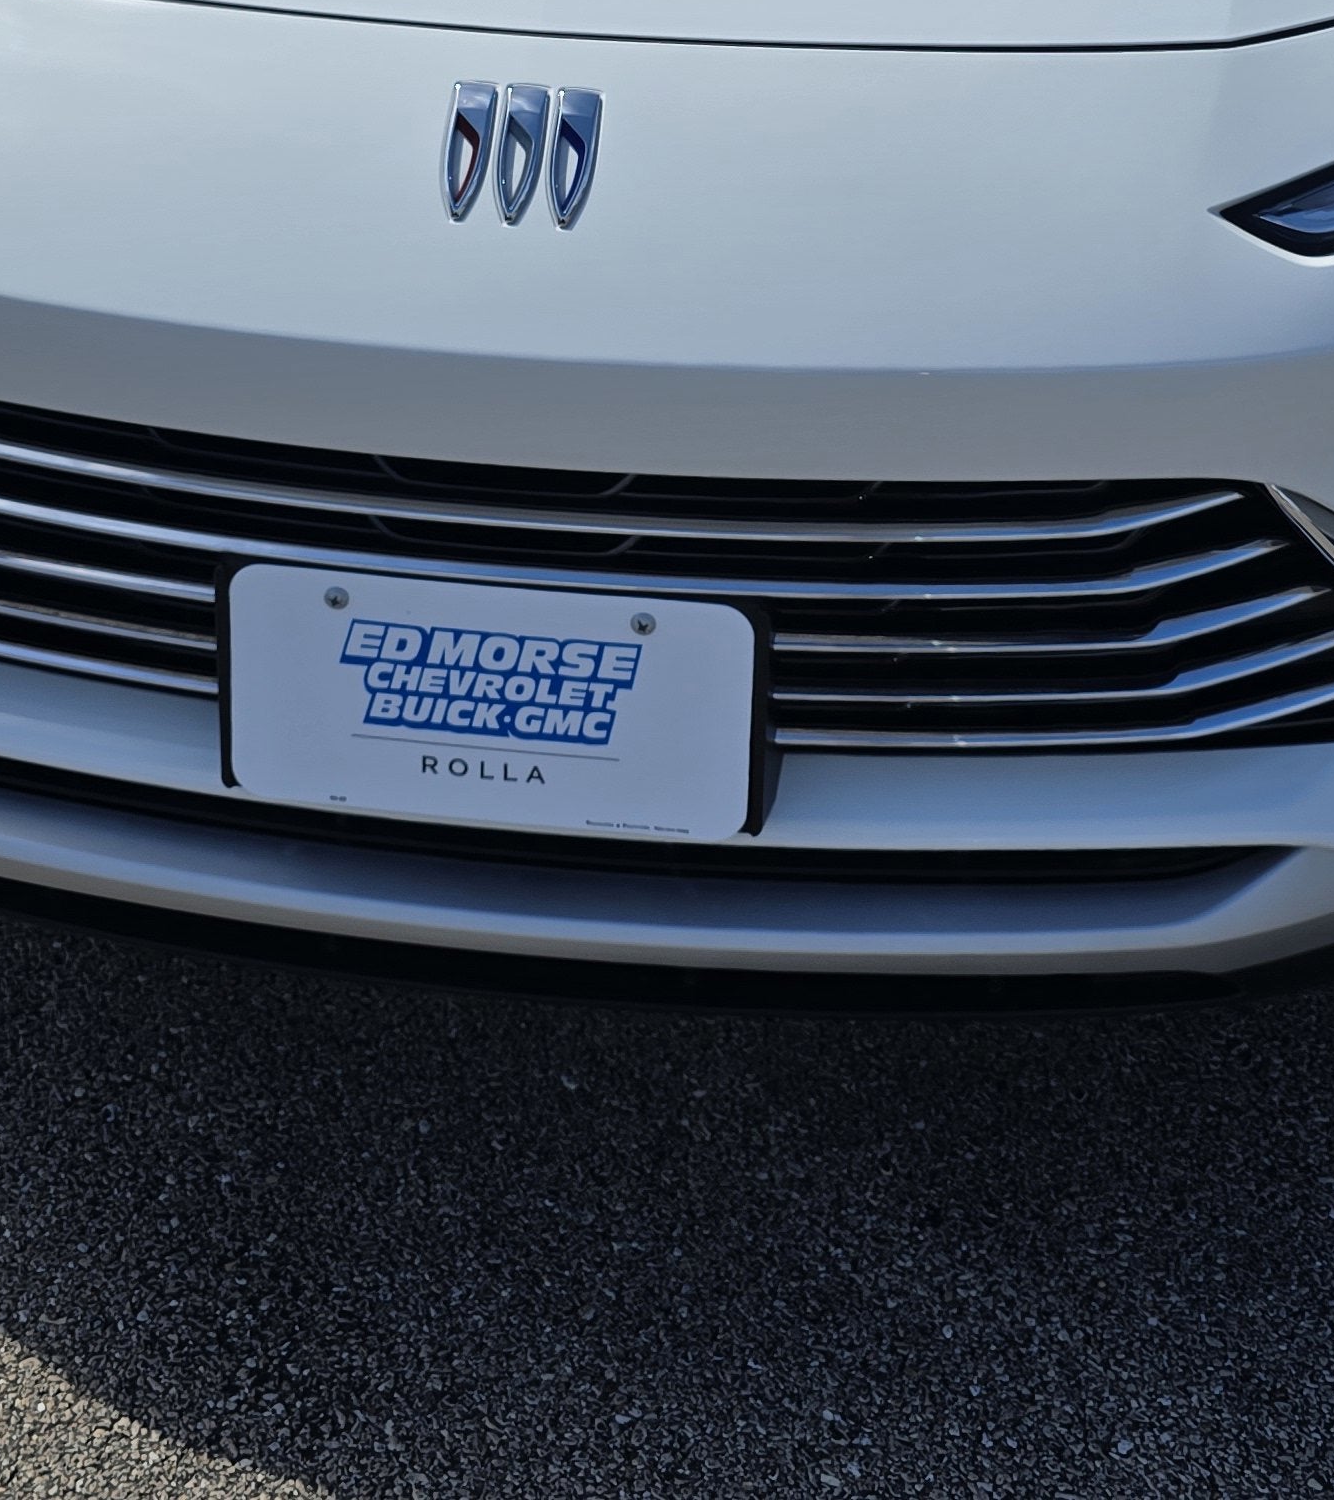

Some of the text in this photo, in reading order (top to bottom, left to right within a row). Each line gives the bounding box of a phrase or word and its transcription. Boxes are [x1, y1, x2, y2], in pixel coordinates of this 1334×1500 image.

[345, 621, 639, 682] ED MORSE
[421, 755, 546, 784] ROLLA
